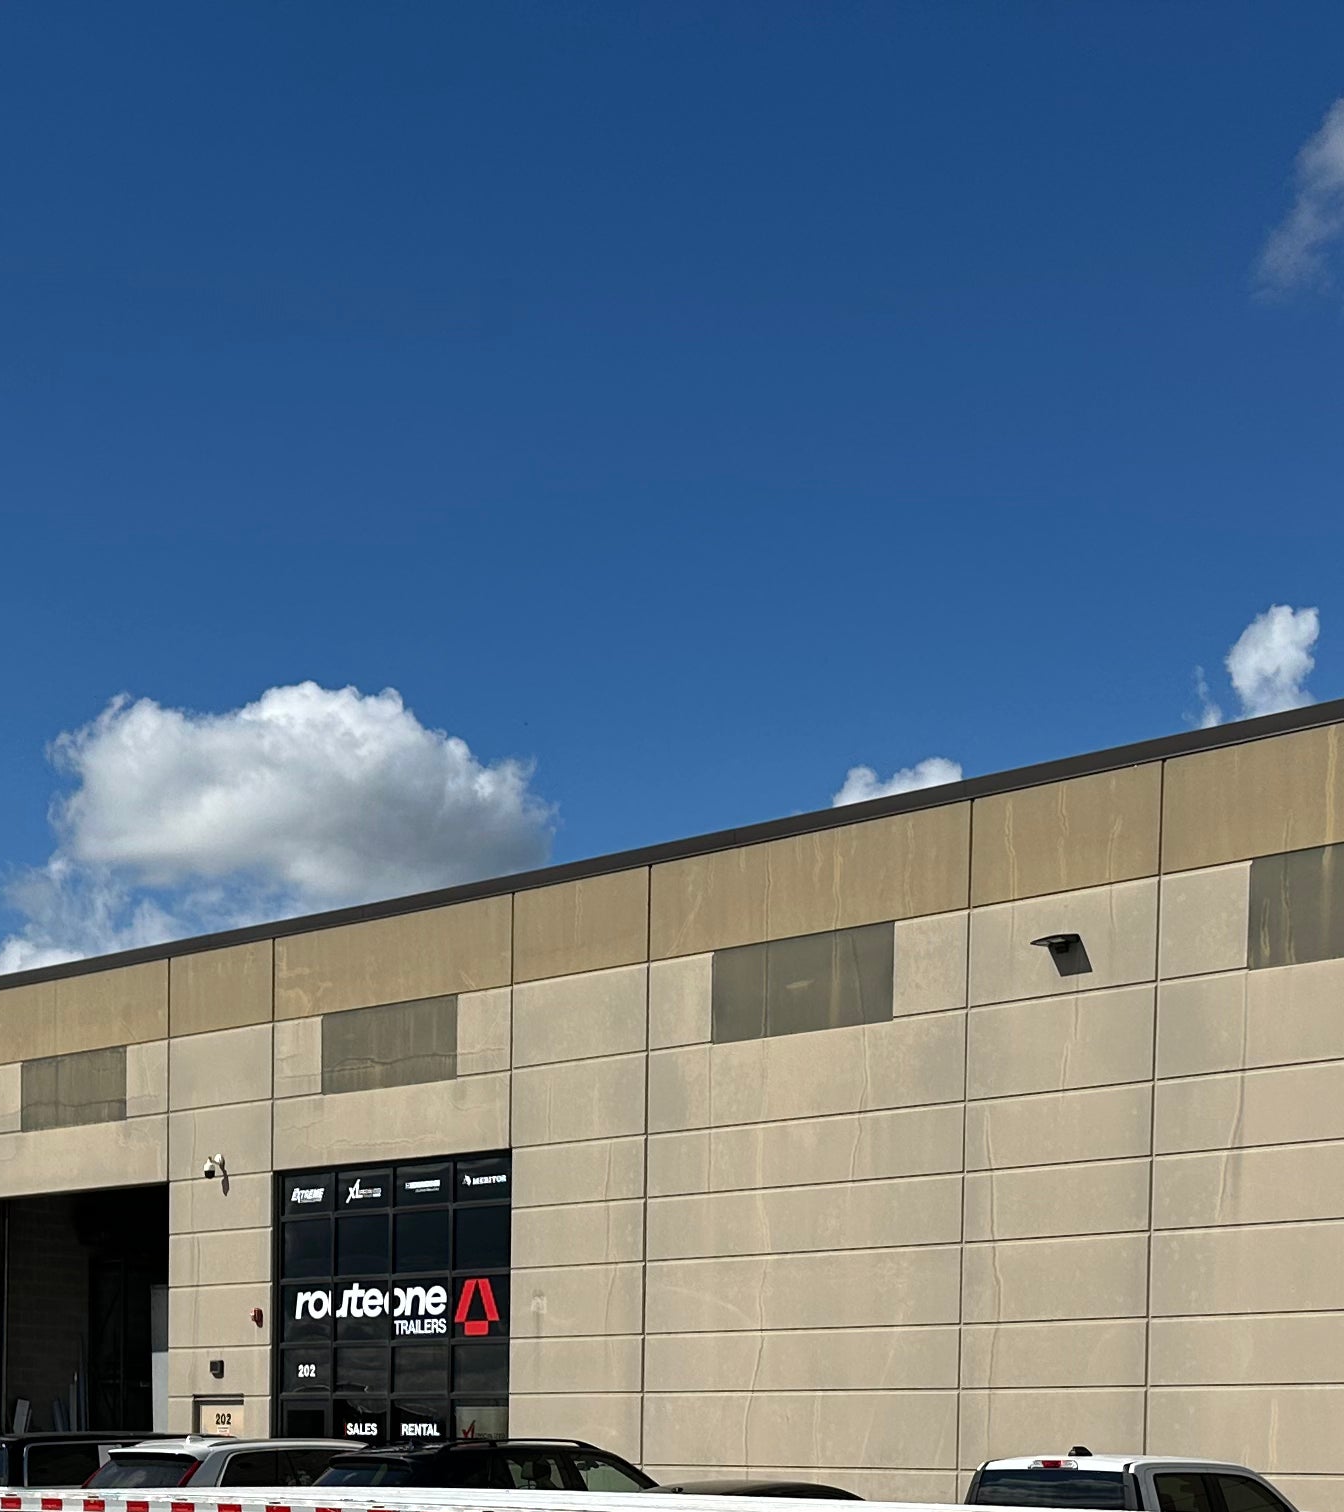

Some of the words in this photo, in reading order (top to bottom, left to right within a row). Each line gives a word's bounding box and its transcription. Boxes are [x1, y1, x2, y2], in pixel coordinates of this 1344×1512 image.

[295, 1283, 447, 1320] routeone
[394, 1318, 446, 1335] TRAILERS
[298, 1364, 316, 1378] 202
[215, 1413, 232, 1425] 202
[346, 1423, 378, 1436] SALES
[401, 1423, 440, 1436] RENTAL
